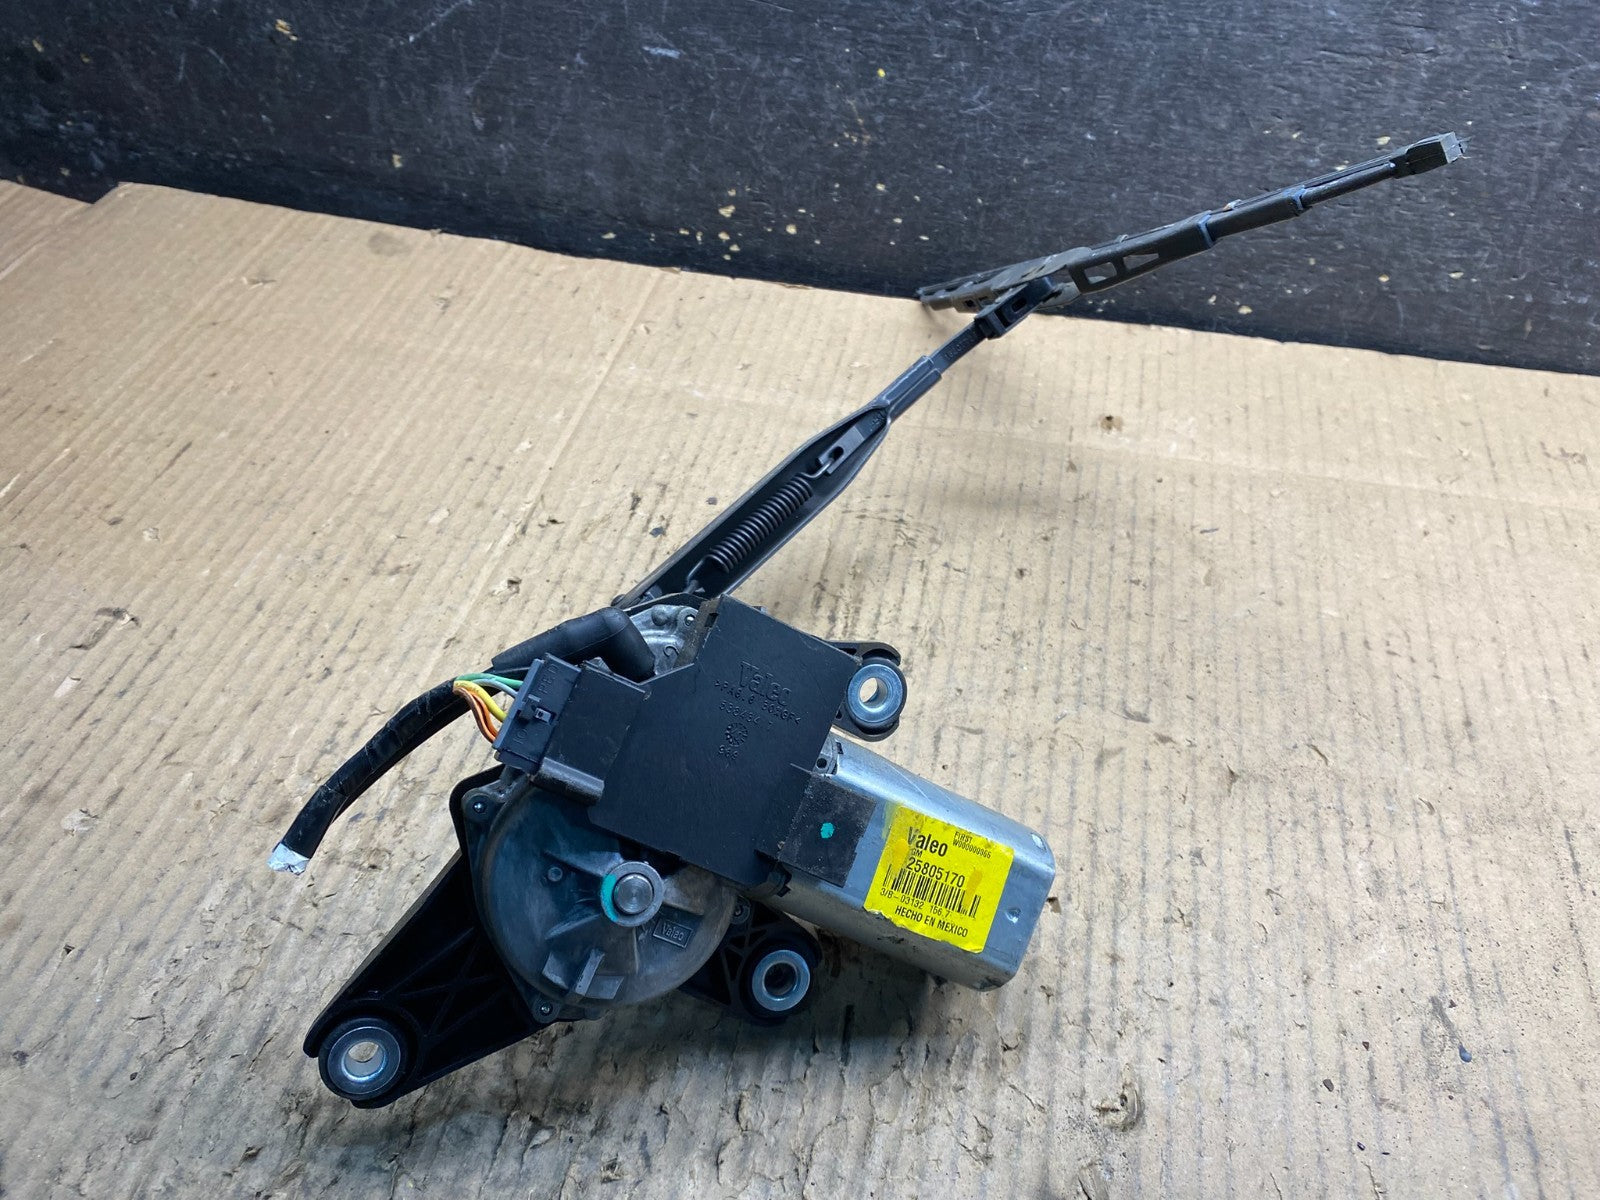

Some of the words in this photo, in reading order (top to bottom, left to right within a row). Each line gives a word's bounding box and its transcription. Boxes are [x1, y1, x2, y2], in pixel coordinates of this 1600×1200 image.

[907, 826, 948, 857] Valeo
[906, 856, 966, 888] 25805170
[662, 921, 685, 941] Valeo
[895, 905, 924, 923] HECHO
[924, 915, 936, 927] EN
[937, 920, 968, 938] MEXICO
